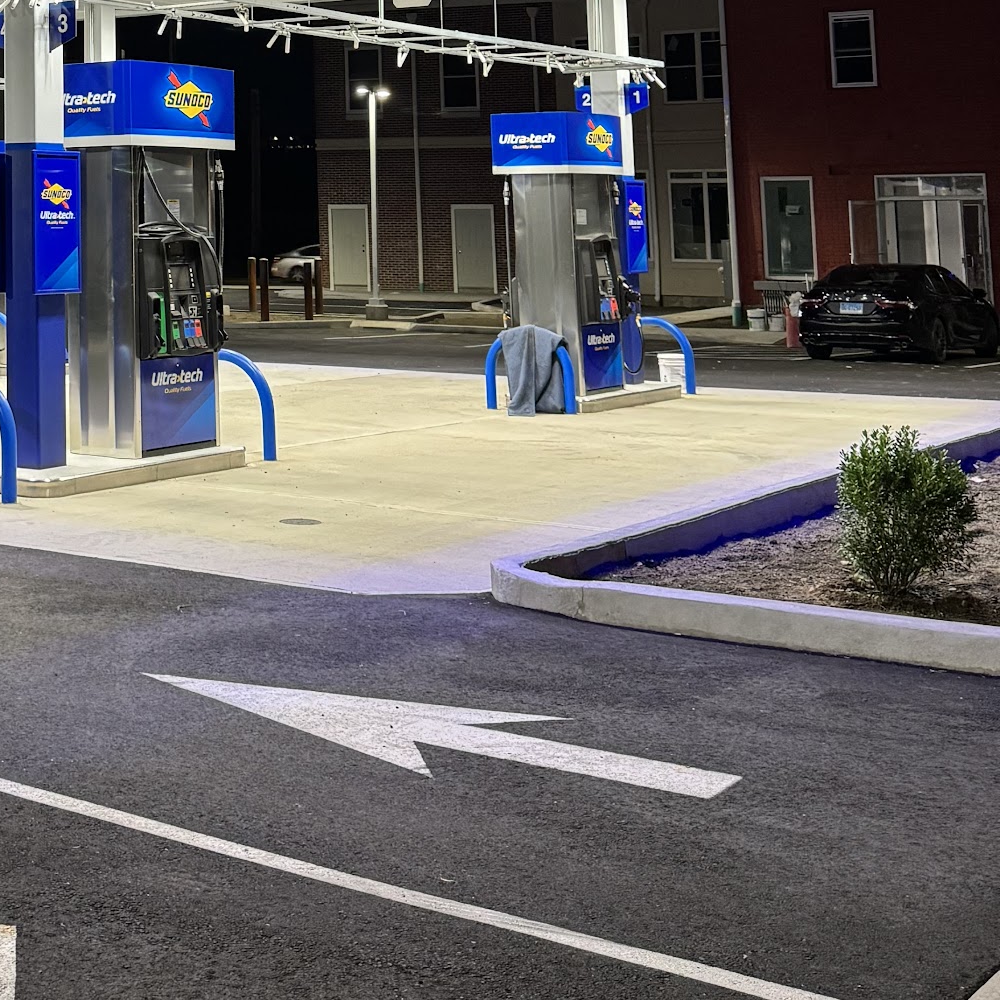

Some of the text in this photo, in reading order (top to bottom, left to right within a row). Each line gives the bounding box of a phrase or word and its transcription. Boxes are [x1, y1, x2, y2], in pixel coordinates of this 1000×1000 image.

[57, 13, 69, 34] 3
[167, 92, 211, 108] SUNOCO
[581, 93, 592, 107] 2
[632, 90, 641, 104] 1
[587, 133, 612, 144] SUNOCO
[42, 190, 71, 199] SUNOCO
